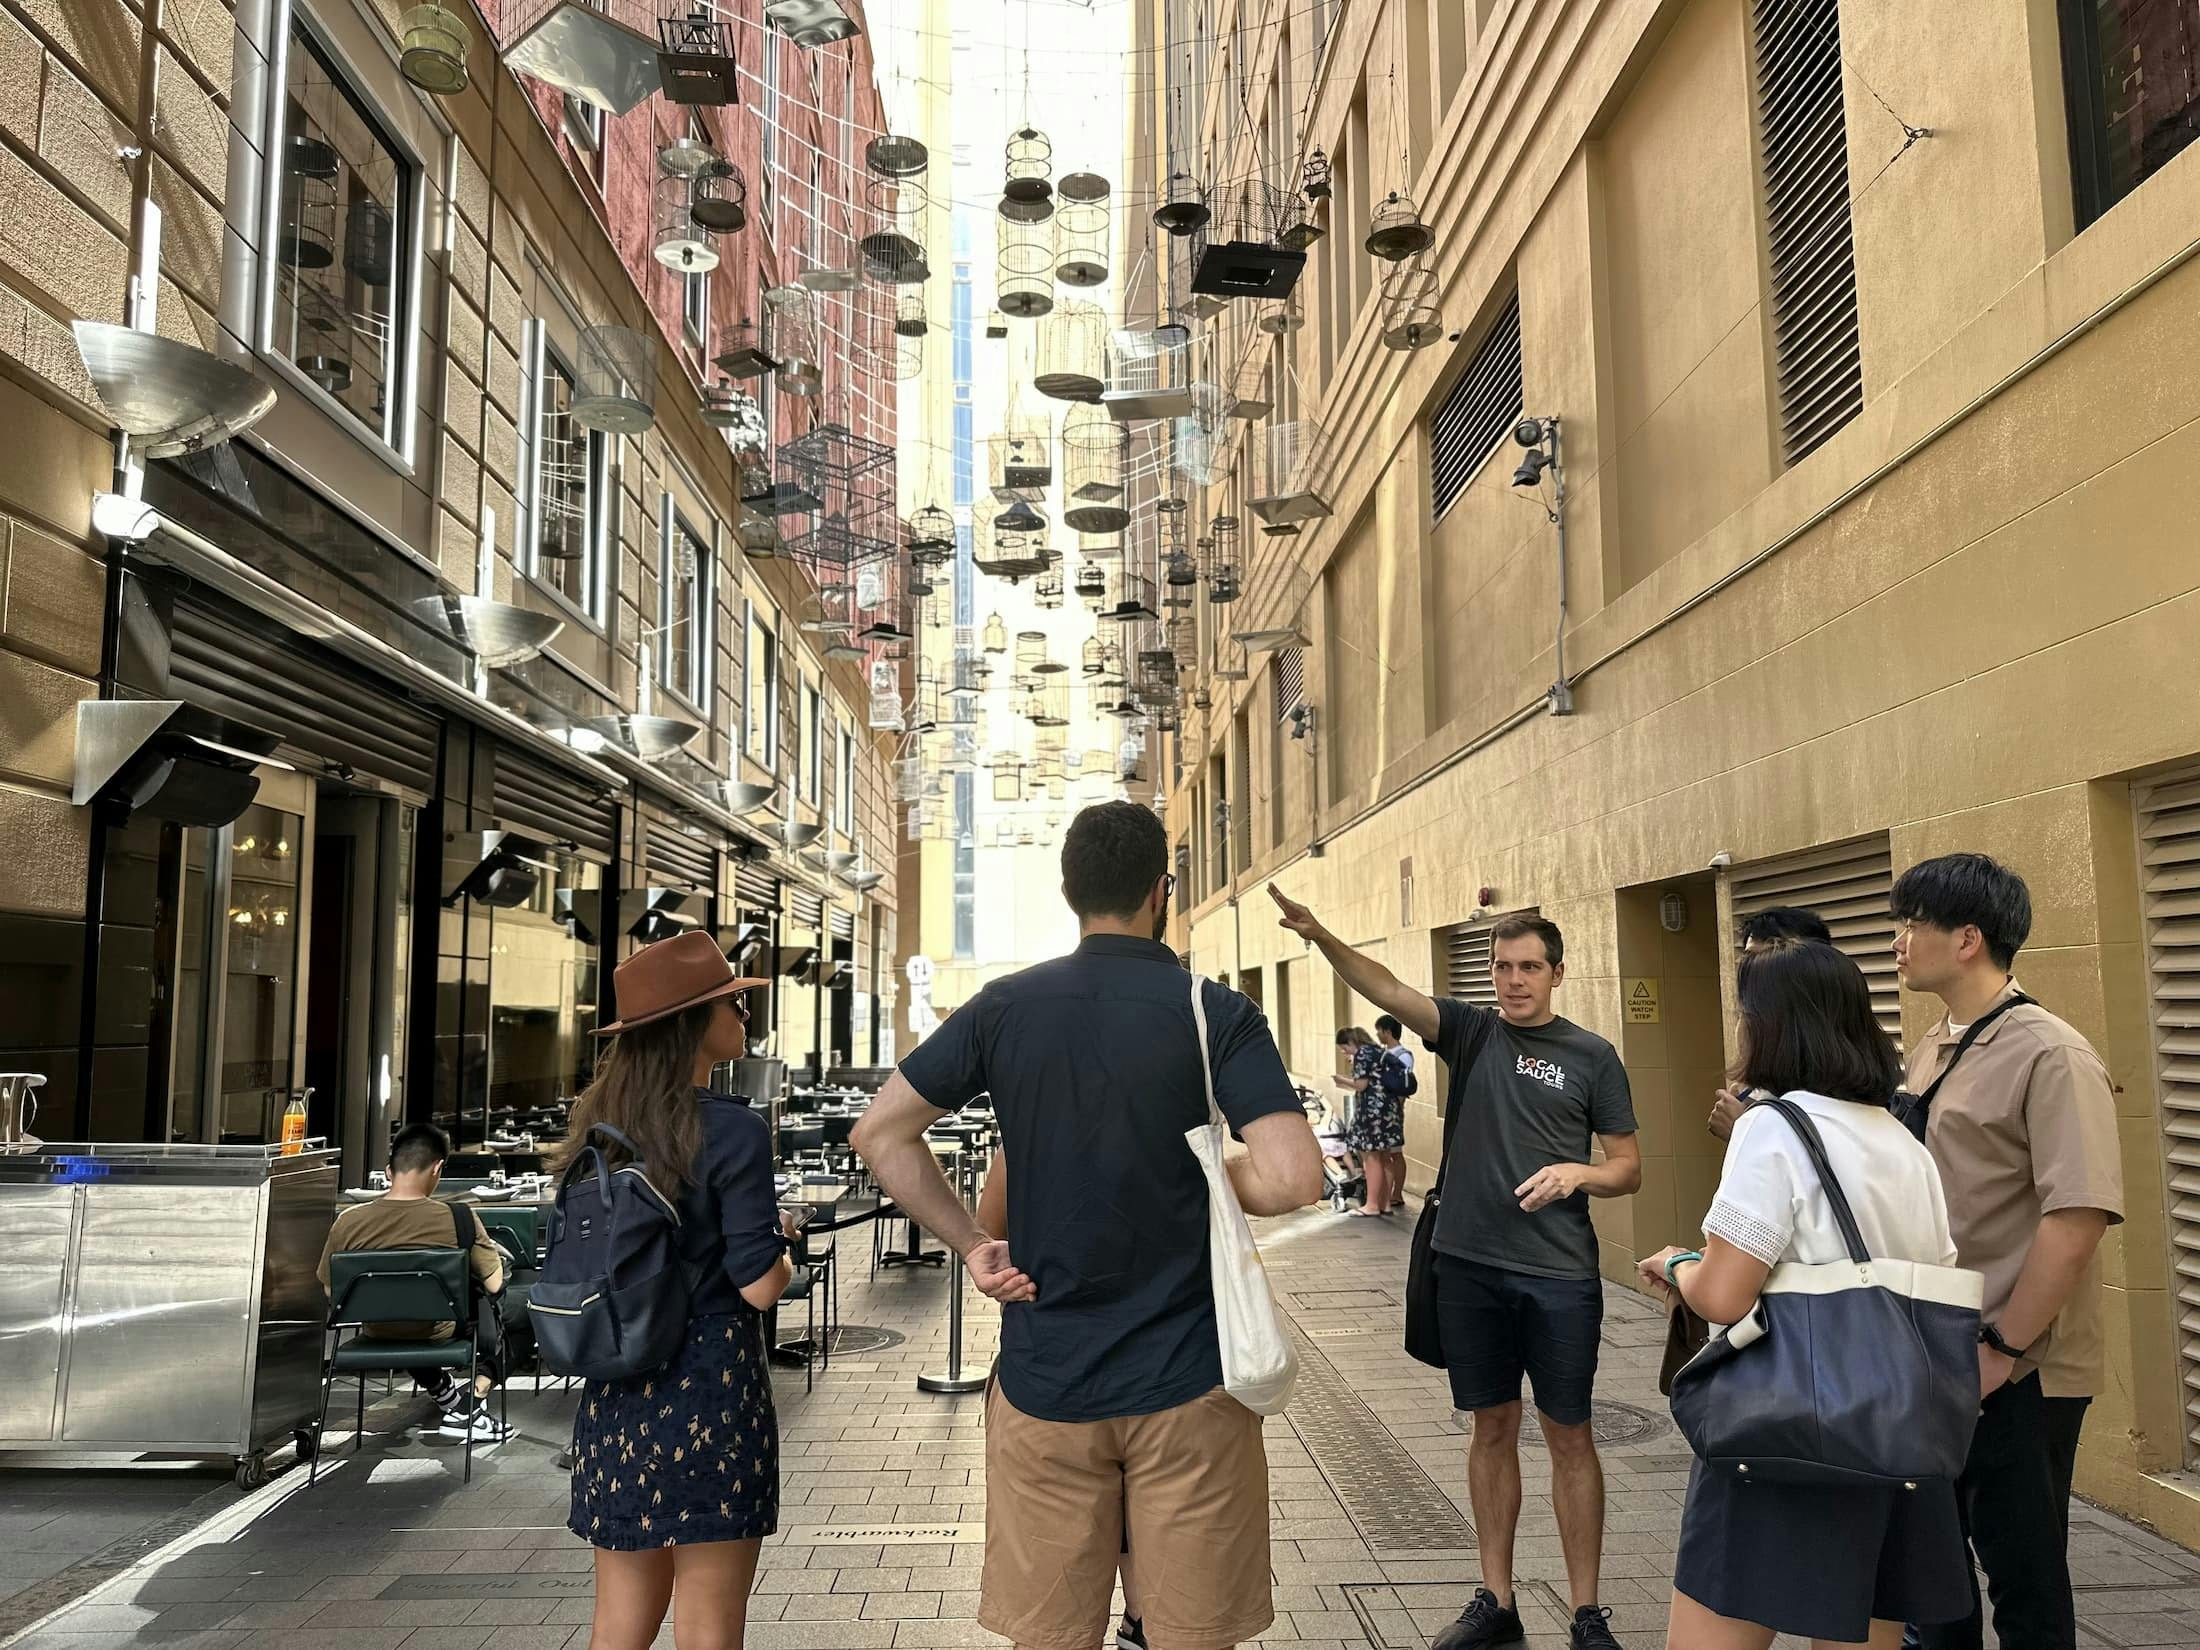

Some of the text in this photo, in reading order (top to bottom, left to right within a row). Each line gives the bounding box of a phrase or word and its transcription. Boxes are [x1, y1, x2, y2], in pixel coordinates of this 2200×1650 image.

[1517, 1054, 1565, 1076] LOCAL
[1516, 1062, 1565, 1086] SAUCE
[1543, 1080, 1564, 1090] TOURS
[812, 1529, 960, 1539] Rockwarbler
[538, 1579, 593, 1589] Owl
